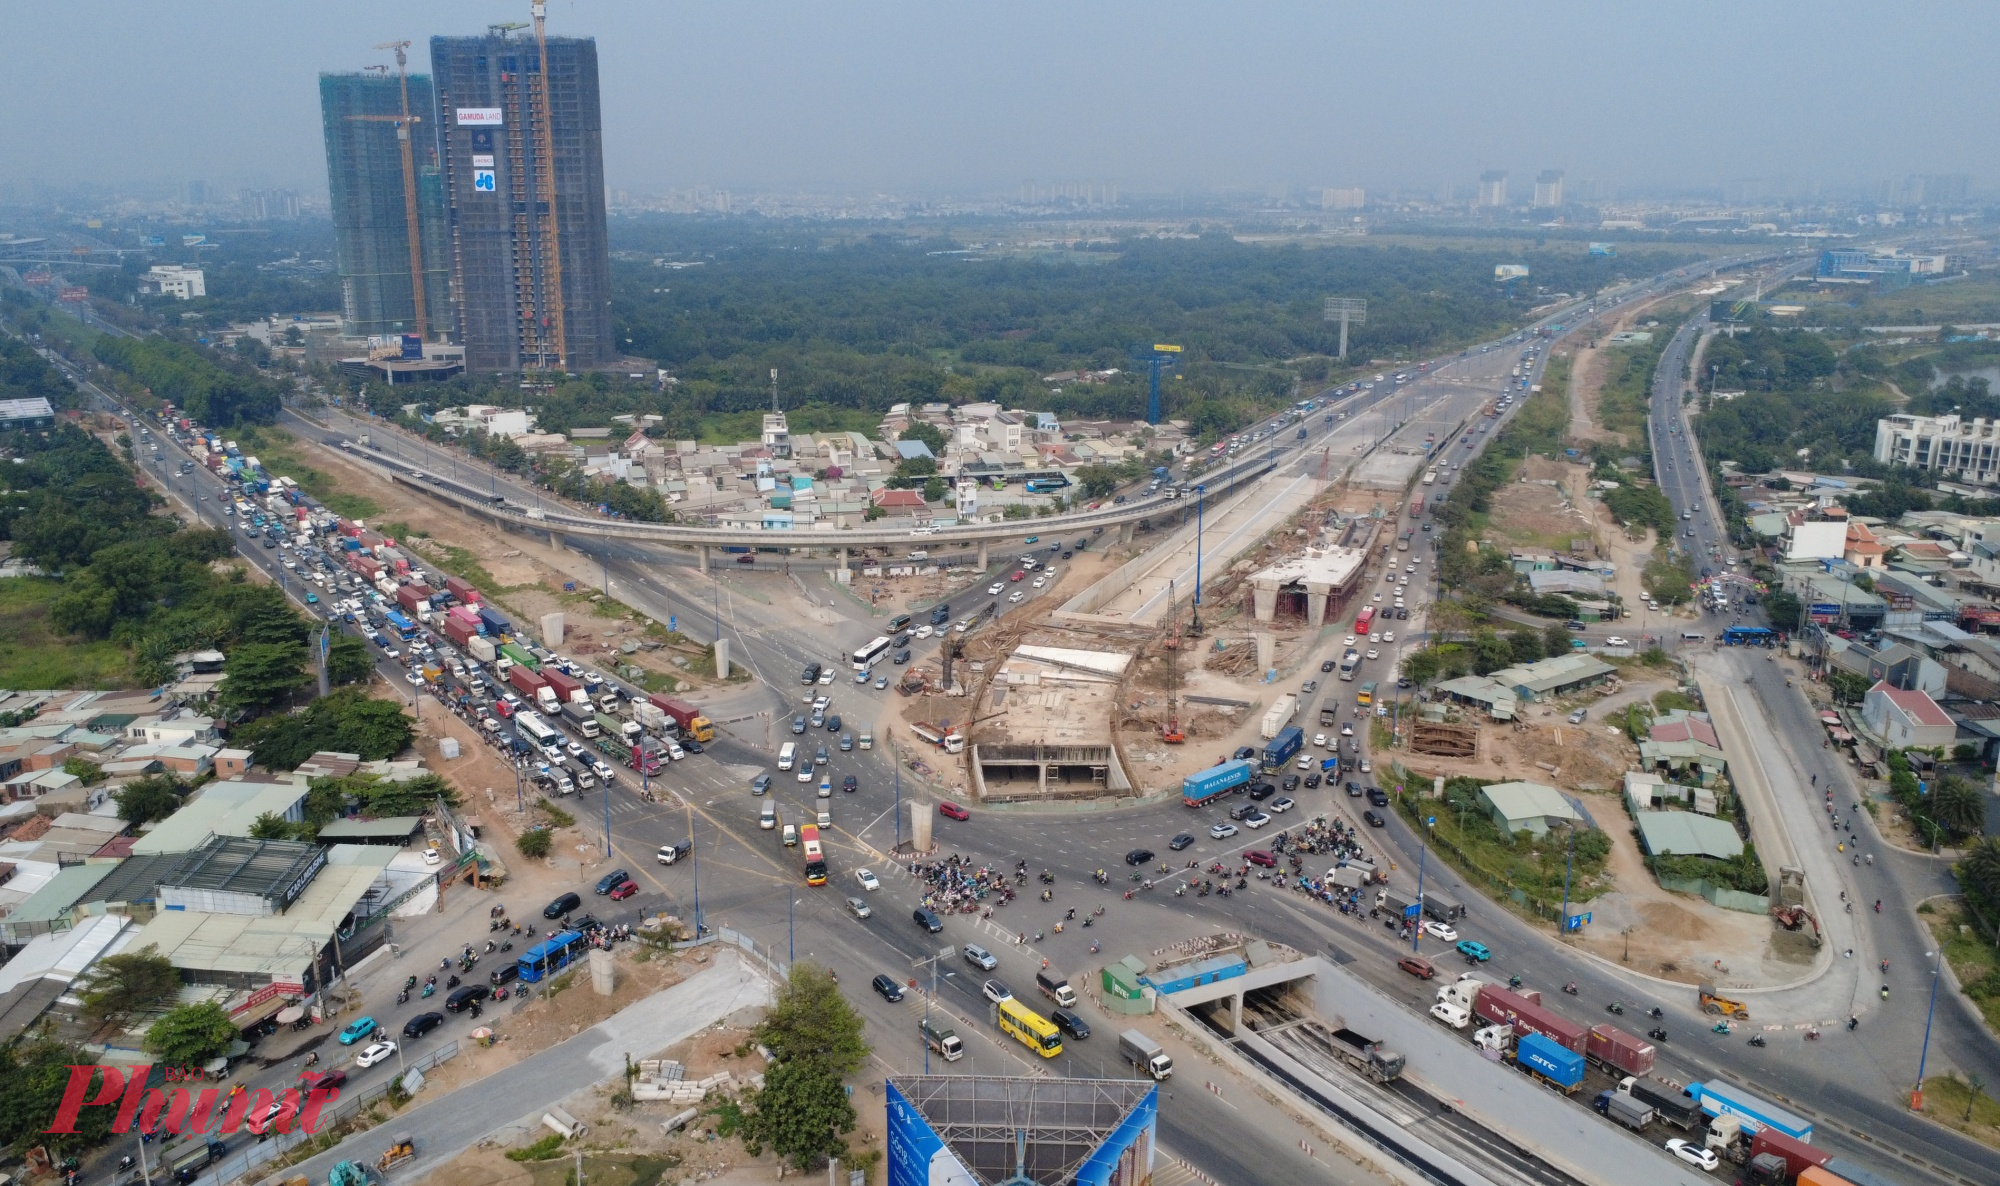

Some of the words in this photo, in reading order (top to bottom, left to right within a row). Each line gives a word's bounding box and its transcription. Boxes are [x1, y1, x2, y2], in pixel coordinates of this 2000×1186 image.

[458, 112, 485, 121] GAMUDA
[485, 112, 501, 121] LAND
[1489, 1003, 1505, 1018] The
[1529, 1053, 1558, 1072] SITC
